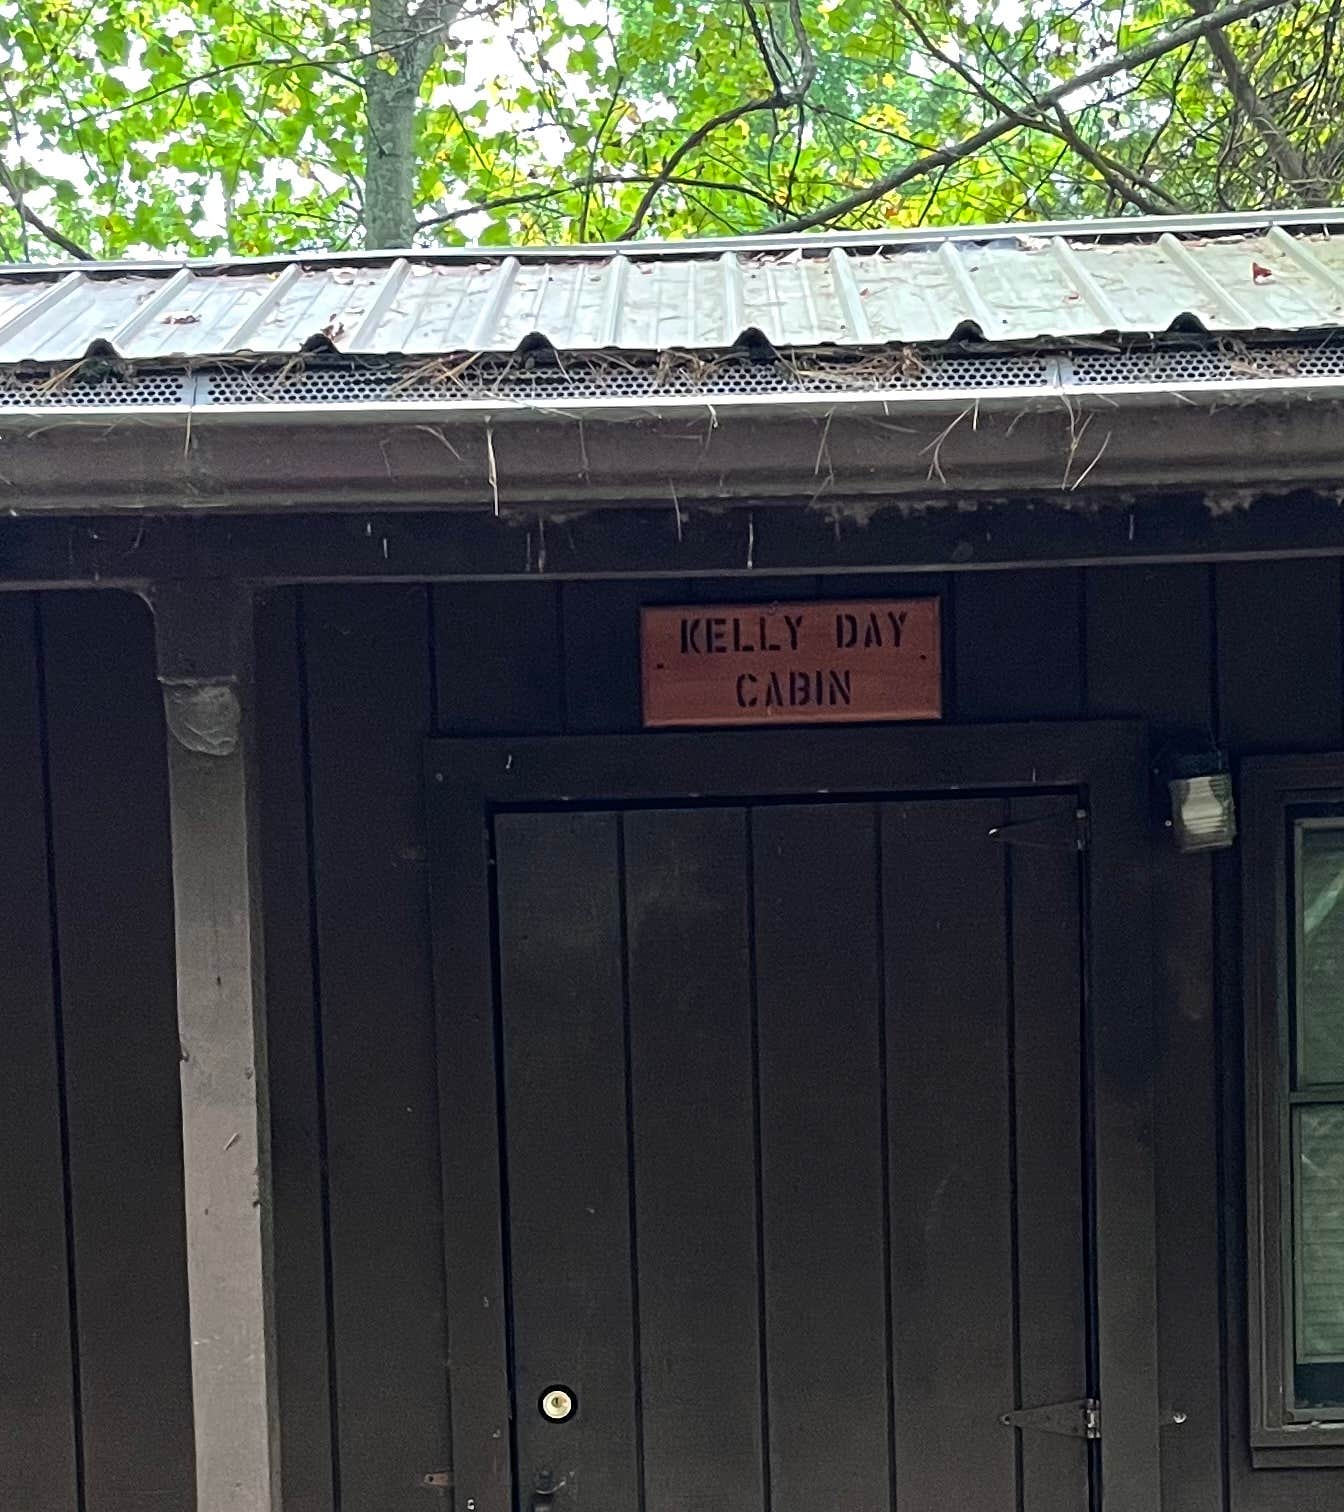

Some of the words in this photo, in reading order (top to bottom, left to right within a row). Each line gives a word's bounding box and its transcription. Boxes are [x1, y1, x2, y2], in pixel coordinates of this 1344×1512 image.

[680, 614, 803, 654] KELLY
[835, 610, 907, 649] DAY
[736, 669, 851, 708] CABIN
